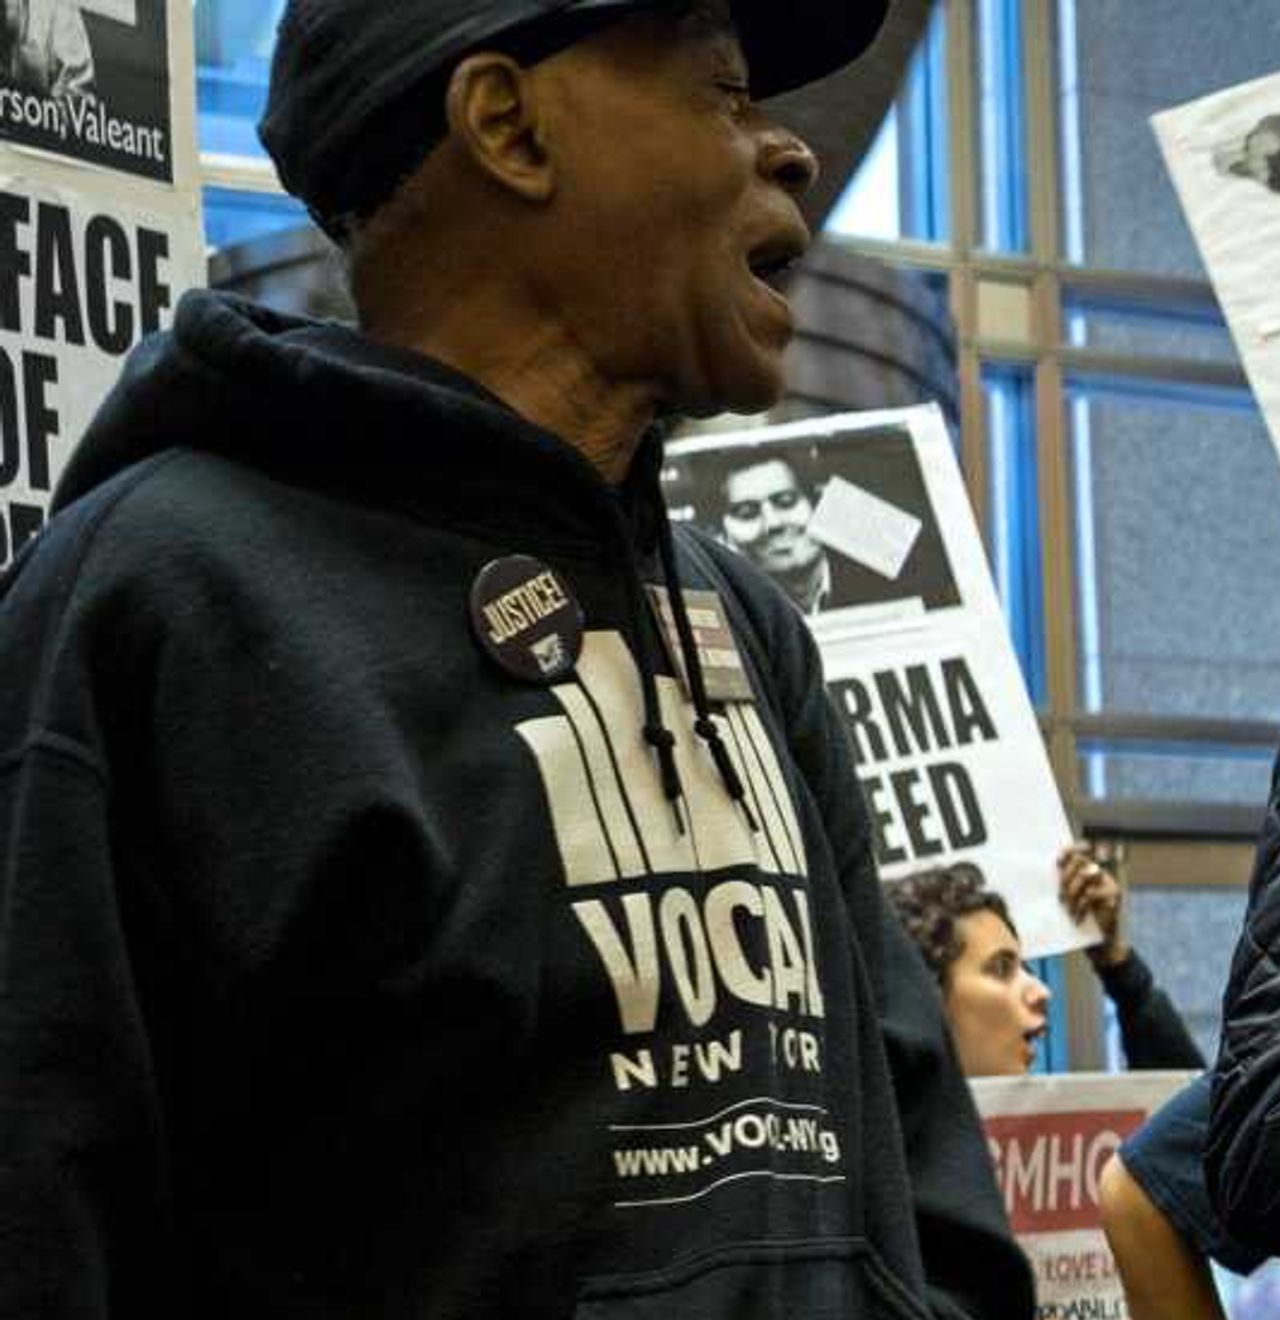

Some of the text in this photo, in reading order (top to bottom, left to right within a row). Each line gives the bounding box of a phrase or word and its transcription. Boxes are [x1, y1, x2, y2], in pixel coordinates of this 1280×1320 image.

[65, 95, 165, 162] Valeant
[482, 569, 569, 643] JUSTICE!
[827, 656, 998, 764] RMA
[610, 1030, 742, 1090] NEW
